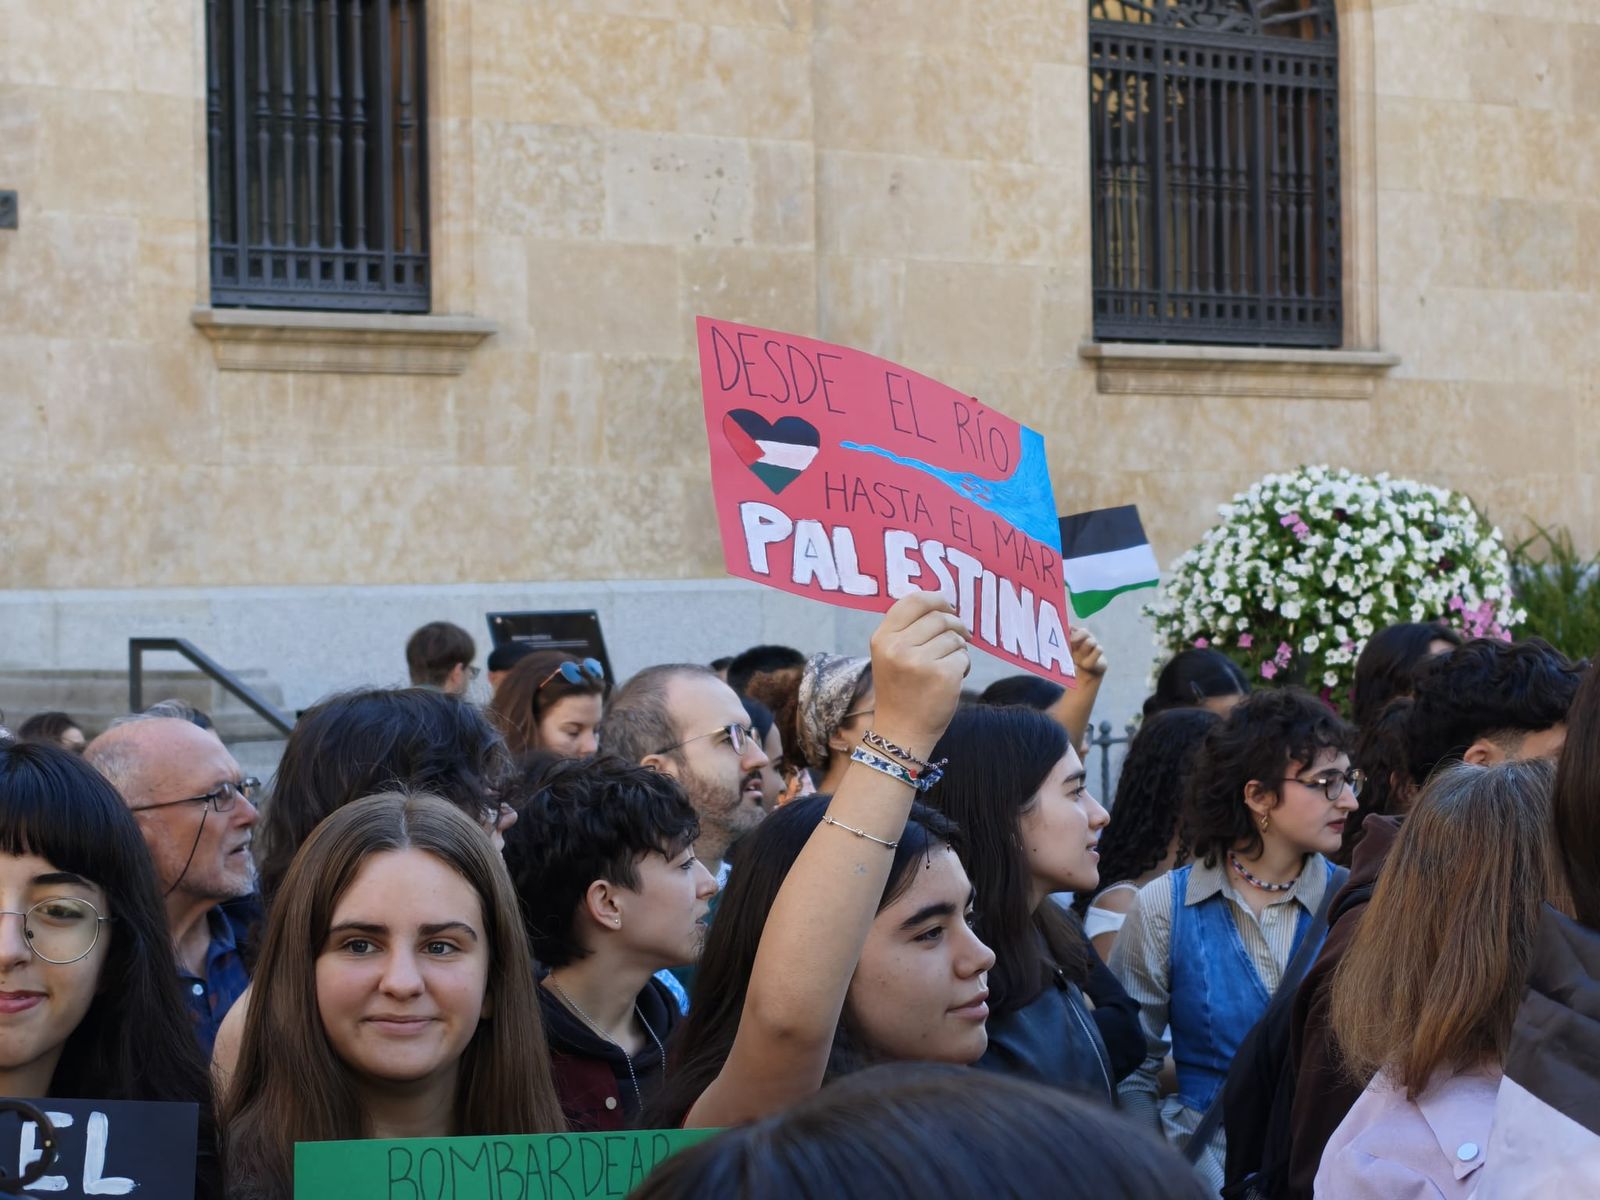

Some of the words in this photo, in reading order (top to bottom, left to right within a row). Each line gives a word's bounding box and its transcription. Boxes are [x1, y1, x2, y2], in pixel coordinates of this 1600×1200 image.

[711, 326, 847, 415] DESDE
[886, 371, 937, 443] EL
[953, 401, 1009, 472] RÍO
[738, 500, 1076, 679] PALESTINA
[824, 471, 934, 527] HASTA
[950, 505, 982, 552] EL
[992, 520, 1058, 588] MAR
